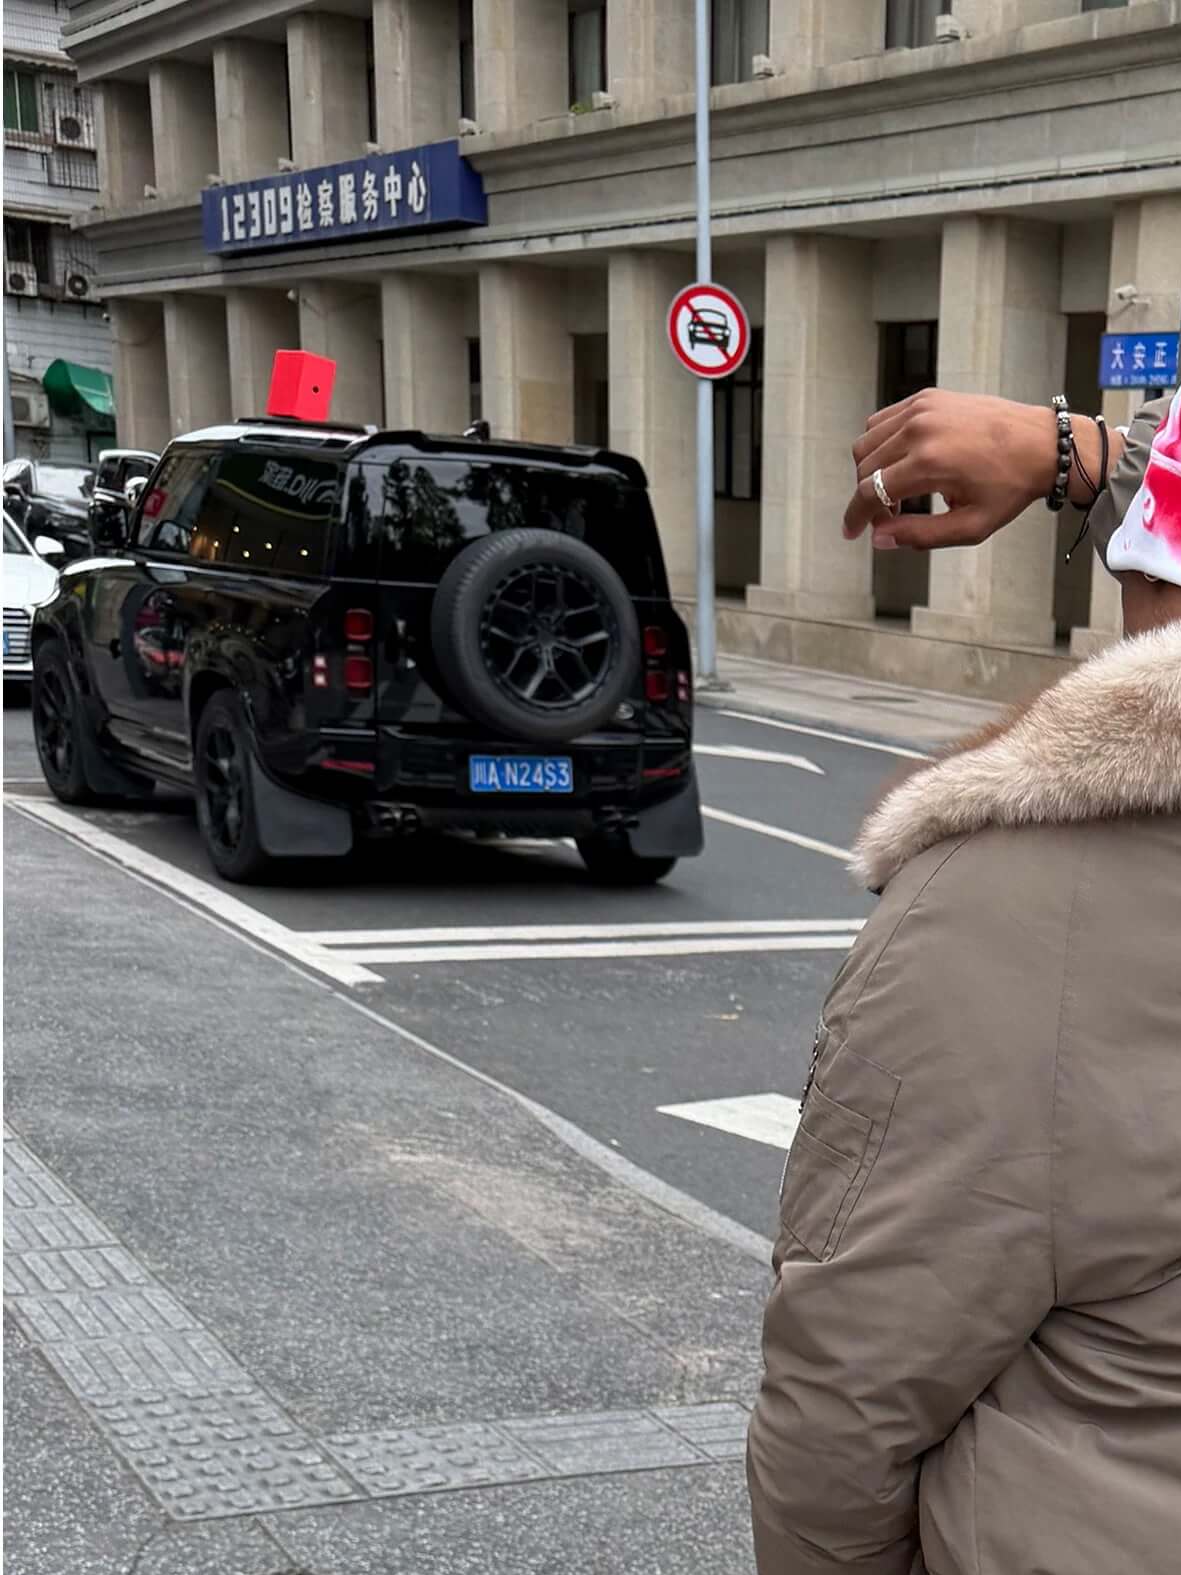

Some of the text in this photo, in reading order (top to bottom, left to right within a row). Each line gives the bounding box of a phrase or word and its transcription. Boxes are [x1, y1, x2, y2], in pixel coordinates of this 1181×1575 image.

[221, 160, 426, 242] 12309检察服务中心
[1110, 341, 1179, 370] 大安正
